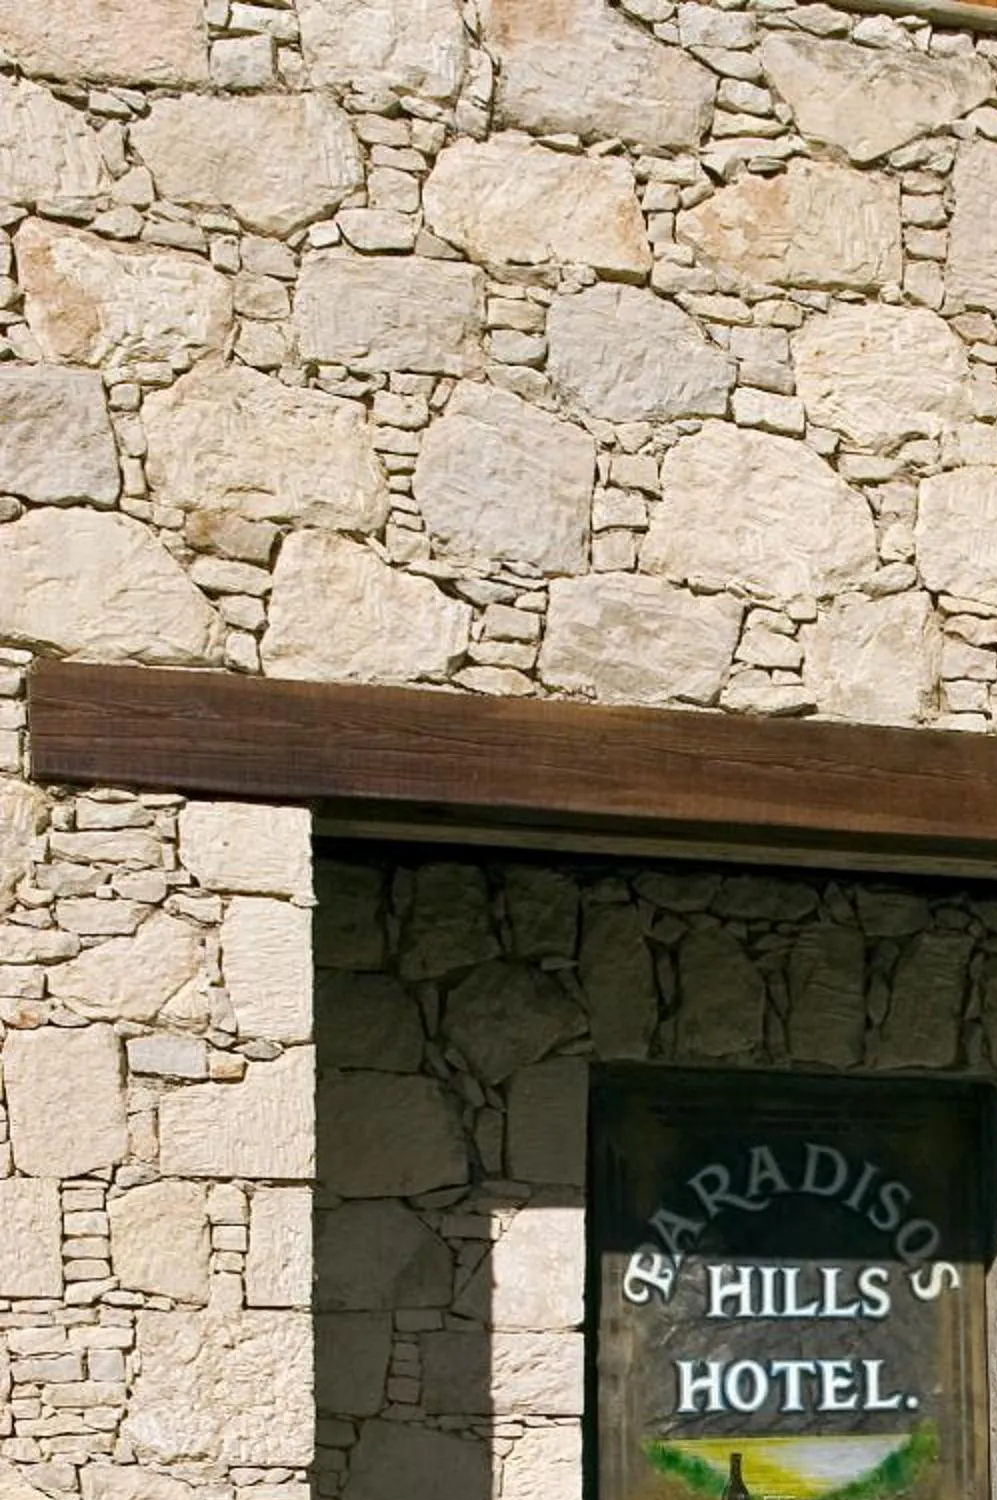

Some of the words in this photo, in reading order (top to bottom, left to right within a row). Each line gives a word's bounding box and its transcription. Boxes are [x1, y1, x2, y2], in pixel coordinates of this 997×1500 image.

[623, 1143, 960, 1304] PARADISOS
[706, 1265, 891, 1318] HILLS
[676, 1359, 919, 1413] HOTEL.
